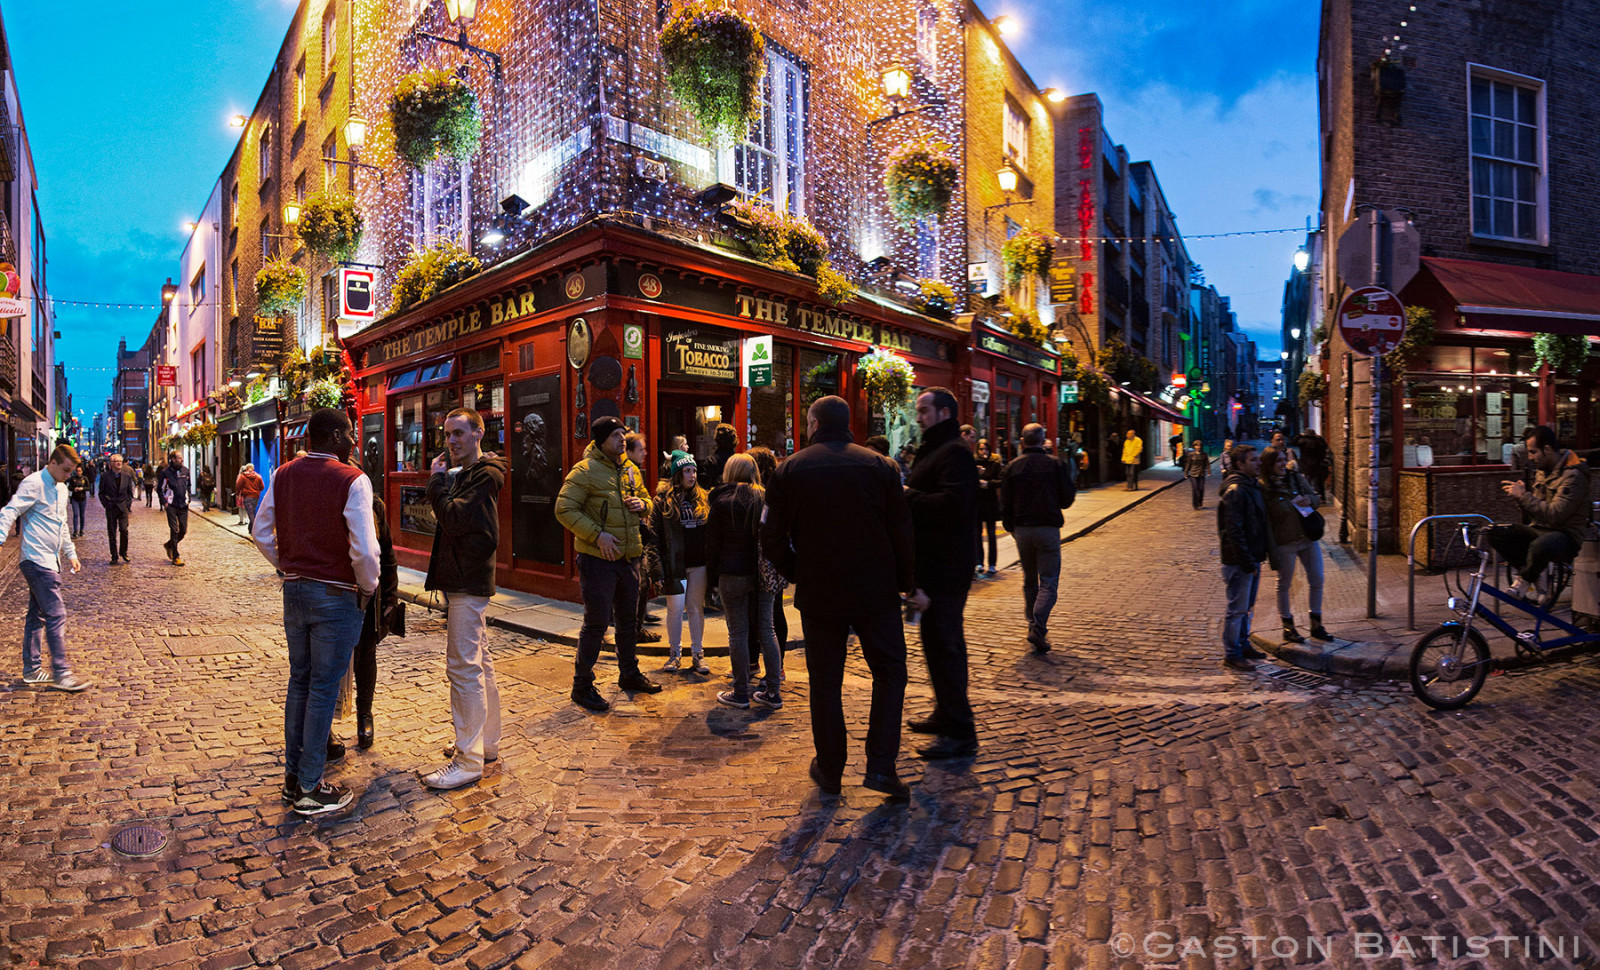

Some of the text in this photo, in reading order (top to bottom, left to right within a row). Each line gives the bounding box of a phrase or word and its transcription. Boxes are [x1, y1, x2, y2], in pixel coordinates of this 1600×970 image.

[568, 279, 582, 295] 48
[643, 277, 658, 293] 48
[1080, 272, 1094, 315] BAR
[383, 291, 536, 361] THE TEMPLE BAR
[735, 294, 912, 352] THE TEMPLE BAR
[675, 344, 730, 371] TOBACCO
[694, 342, 730, 353] FINE SMOKING
[686, 366, 708, 376] Always
[717, 369, 735, 378] Stock
